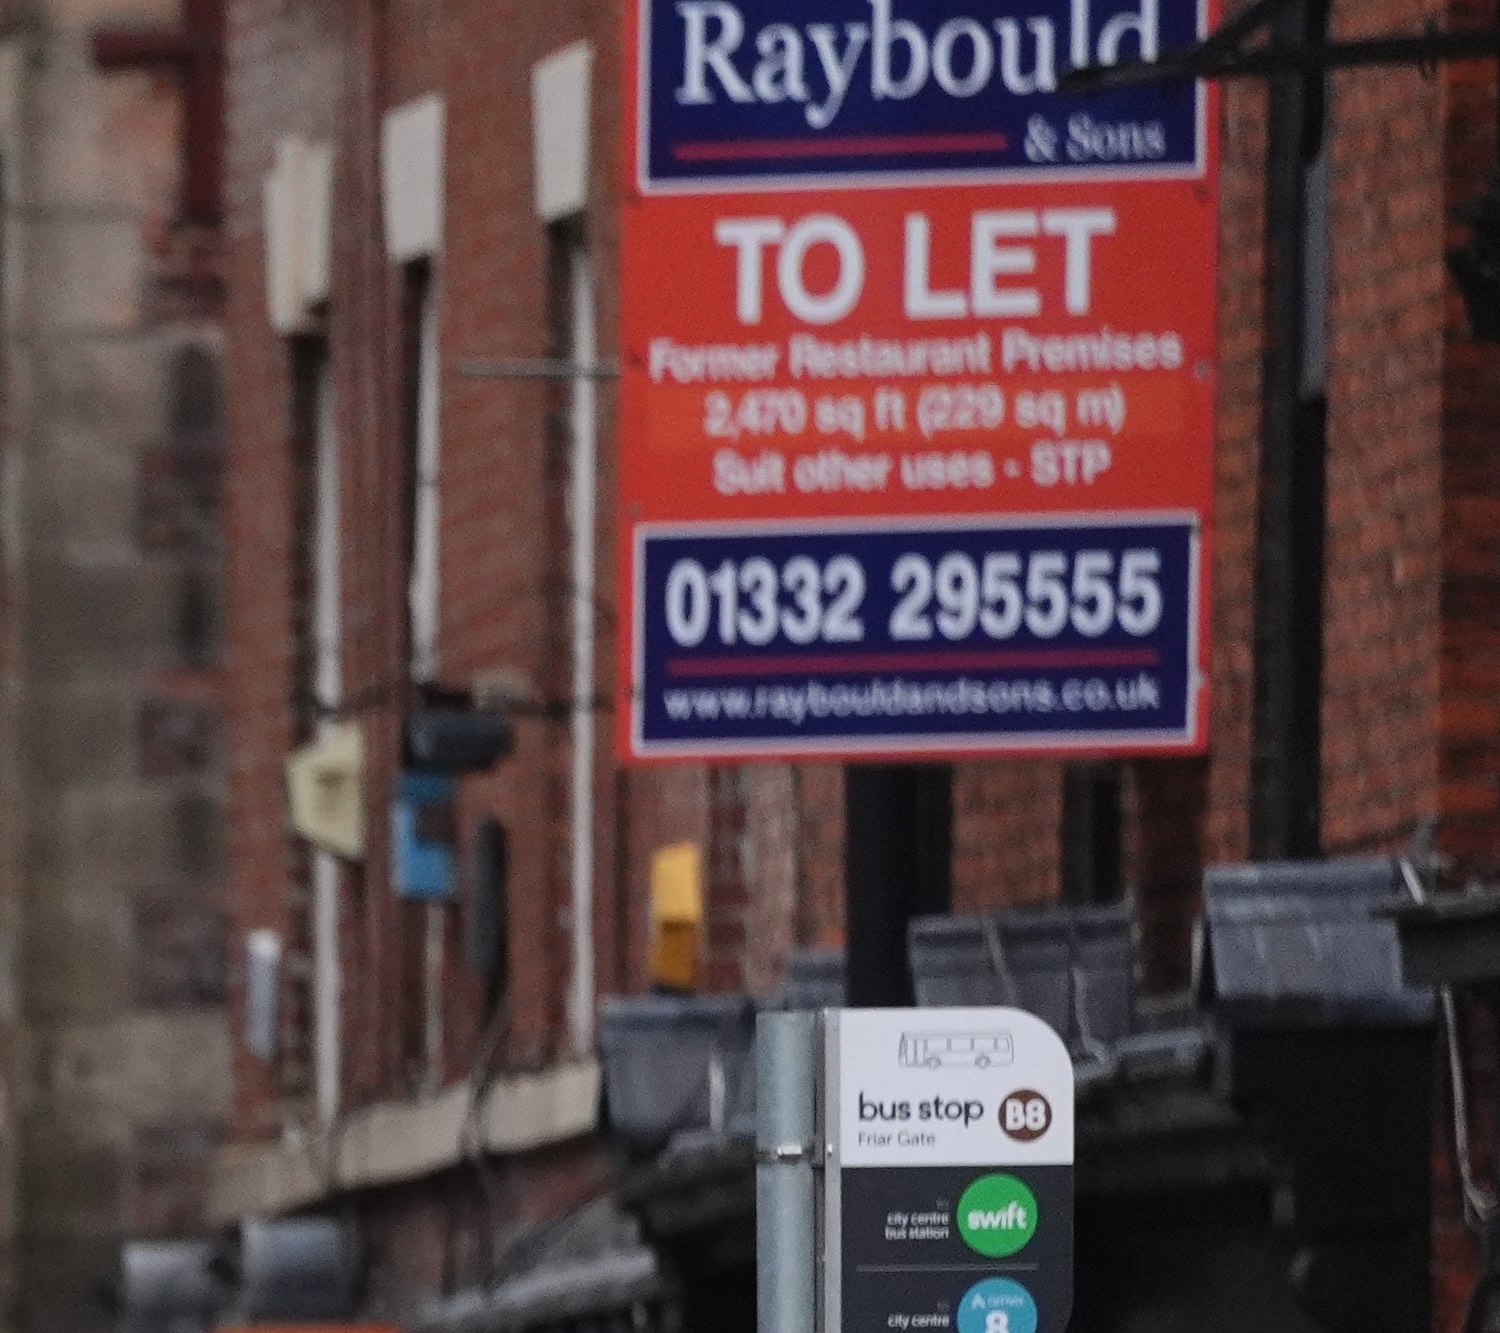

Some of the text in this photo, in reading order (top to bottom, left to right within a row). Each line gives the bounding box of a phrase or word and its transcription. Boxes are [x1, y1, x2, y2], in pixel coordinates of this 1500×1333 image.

[673, 0, 1159, 129] Raybould
[1023, 111, 1167, 162] & Sons
[713, 206, 1117, 326] TO LET
[648, 326, 1185, 384] Former Restaurant Premises
[703, 388, 808, 439] 2,470
[814, 394, 866, 441] sq
[874, 386, 906, 430] ft
[1013, 389, 1067, 437] sq
[1075, 381, 1128, 434] m)
[712, 448, 786, 496] Suit
[793, 447, 895, 491] other
[901, 453, 995, 490] uses
[1029, 438, 1111, 487] STP
[664, 547, 1163, 648] 01332 295555
[663, 672, 1161, 726] www.raybouldandsons.co.uk
[858, 1091, 985, 1129] bus stop
[1005, 1098, 1047, 1132] B8
[857, 1131, 936, 1147] Friar Gate
[885, 1226, 950, 1239] bus station
[887, 1211, 950, 1228] city centre
[966, 1202, 1028, 1231] swift
[888, 1313, 950, 1329] city centre
